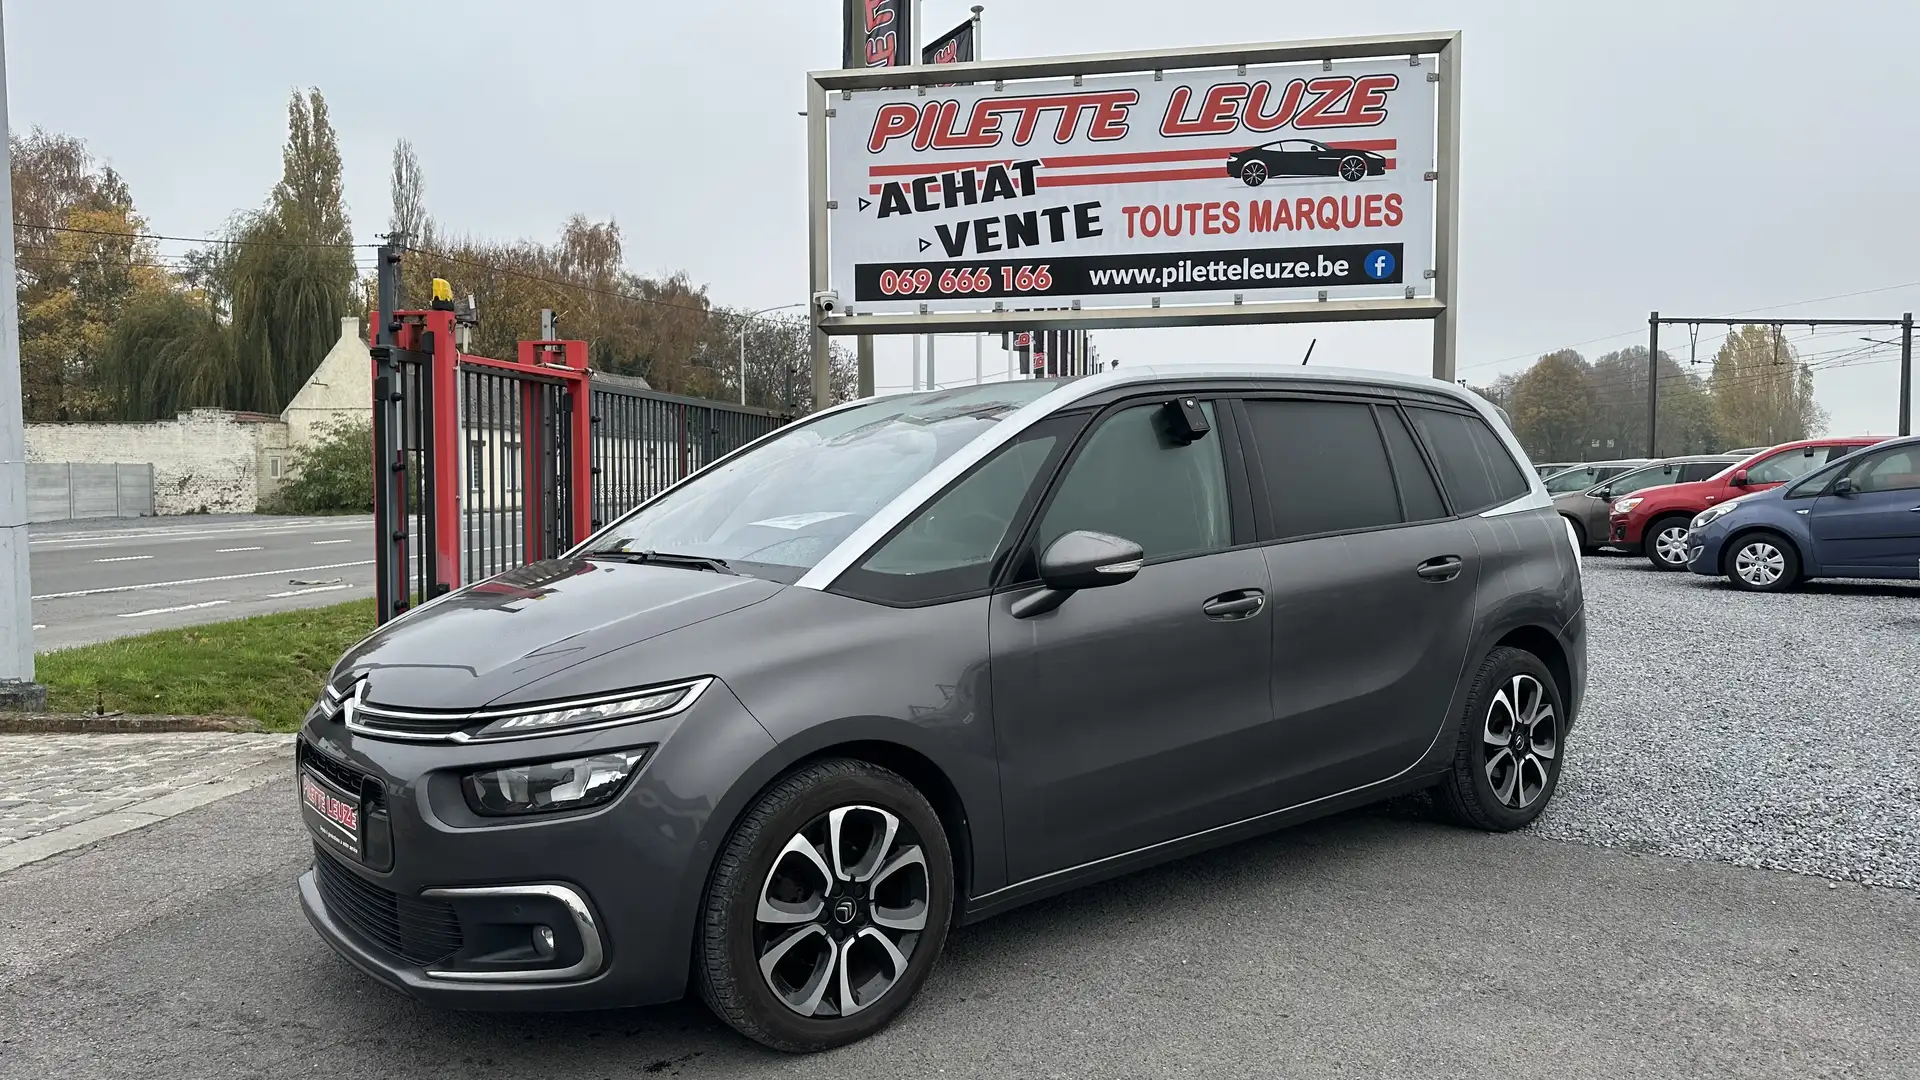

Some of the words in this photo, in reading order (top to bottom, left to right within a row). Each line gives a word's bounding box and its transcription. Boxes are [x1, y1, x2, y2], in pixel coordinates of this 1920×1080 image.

[867, 89, 1139, 153] PILETTE
[1159, 74, 1399, 137] LEUZE
[877, 159, 1041, 219] ACHAT
[934, 201, 1103, 258] VENTE
[1121, 201, 1240, 239] TOUTES
[1249, 193, 1404, 233] MARQUES
[880, 268, 932, 295] 069
[938, 267, 992, 293] 666
[1000, 265, 1052, 291] 166
[1089, 255, 1350, 288] www.piletteleuze.be
[325, 794, 357, 830] LEUZE
